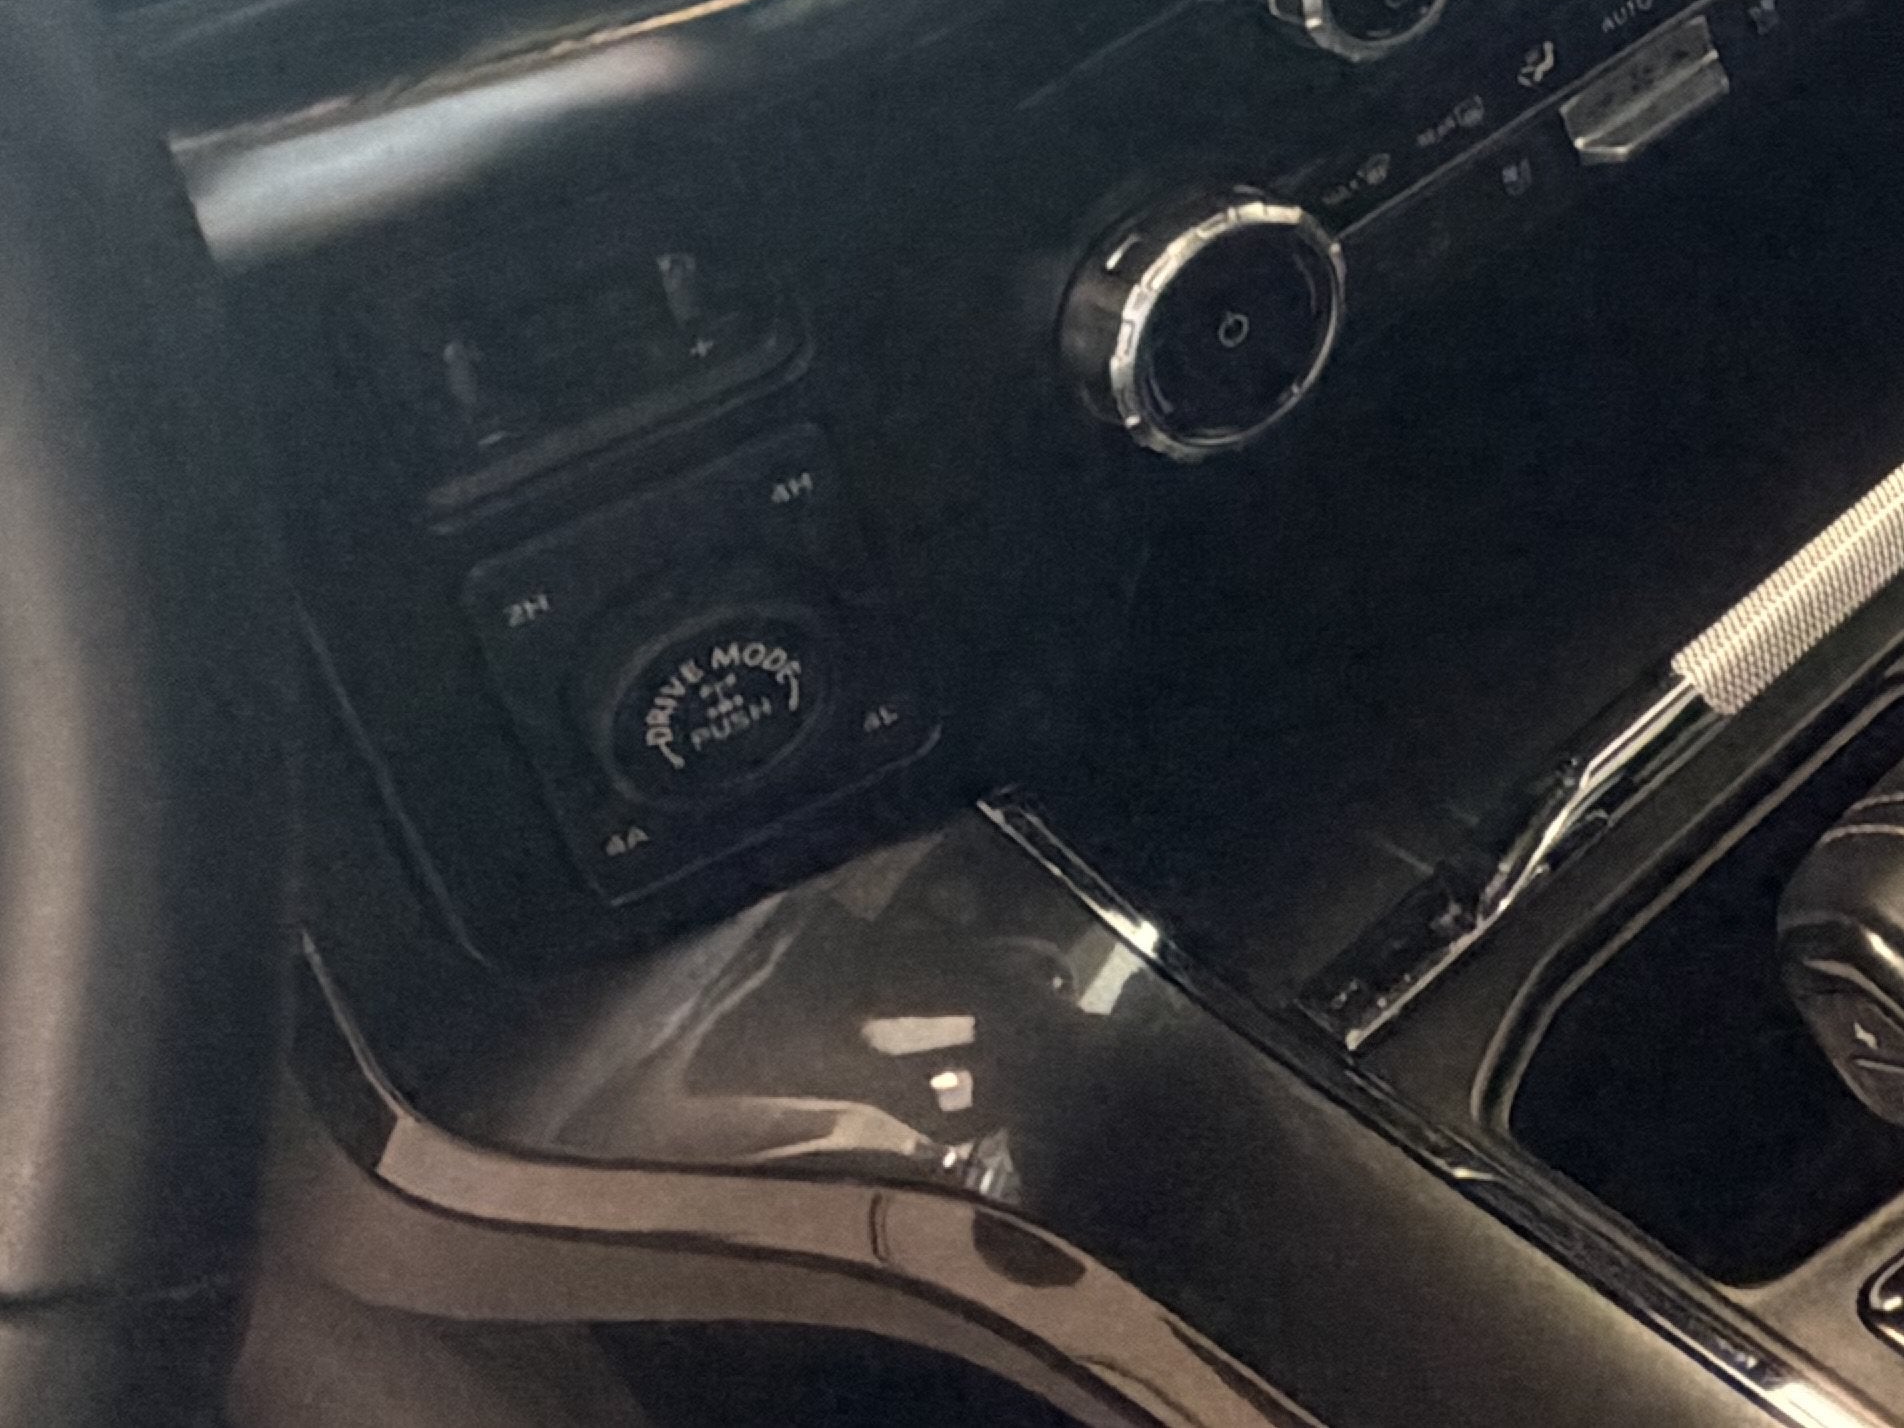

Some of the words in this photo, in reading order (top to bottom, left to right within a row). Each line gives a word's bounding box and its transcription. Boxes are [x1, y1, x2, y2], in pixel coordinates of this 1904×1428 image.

[770, 471, 813, 504] 4H
[508, 594, 549, 628] 2H
[646, 660, 704, 745] DRIVE
[711, 642, 801, 685] MODE
[690, 695, 773, 752] PUSH
[605, 826, 650, 856] 4A
